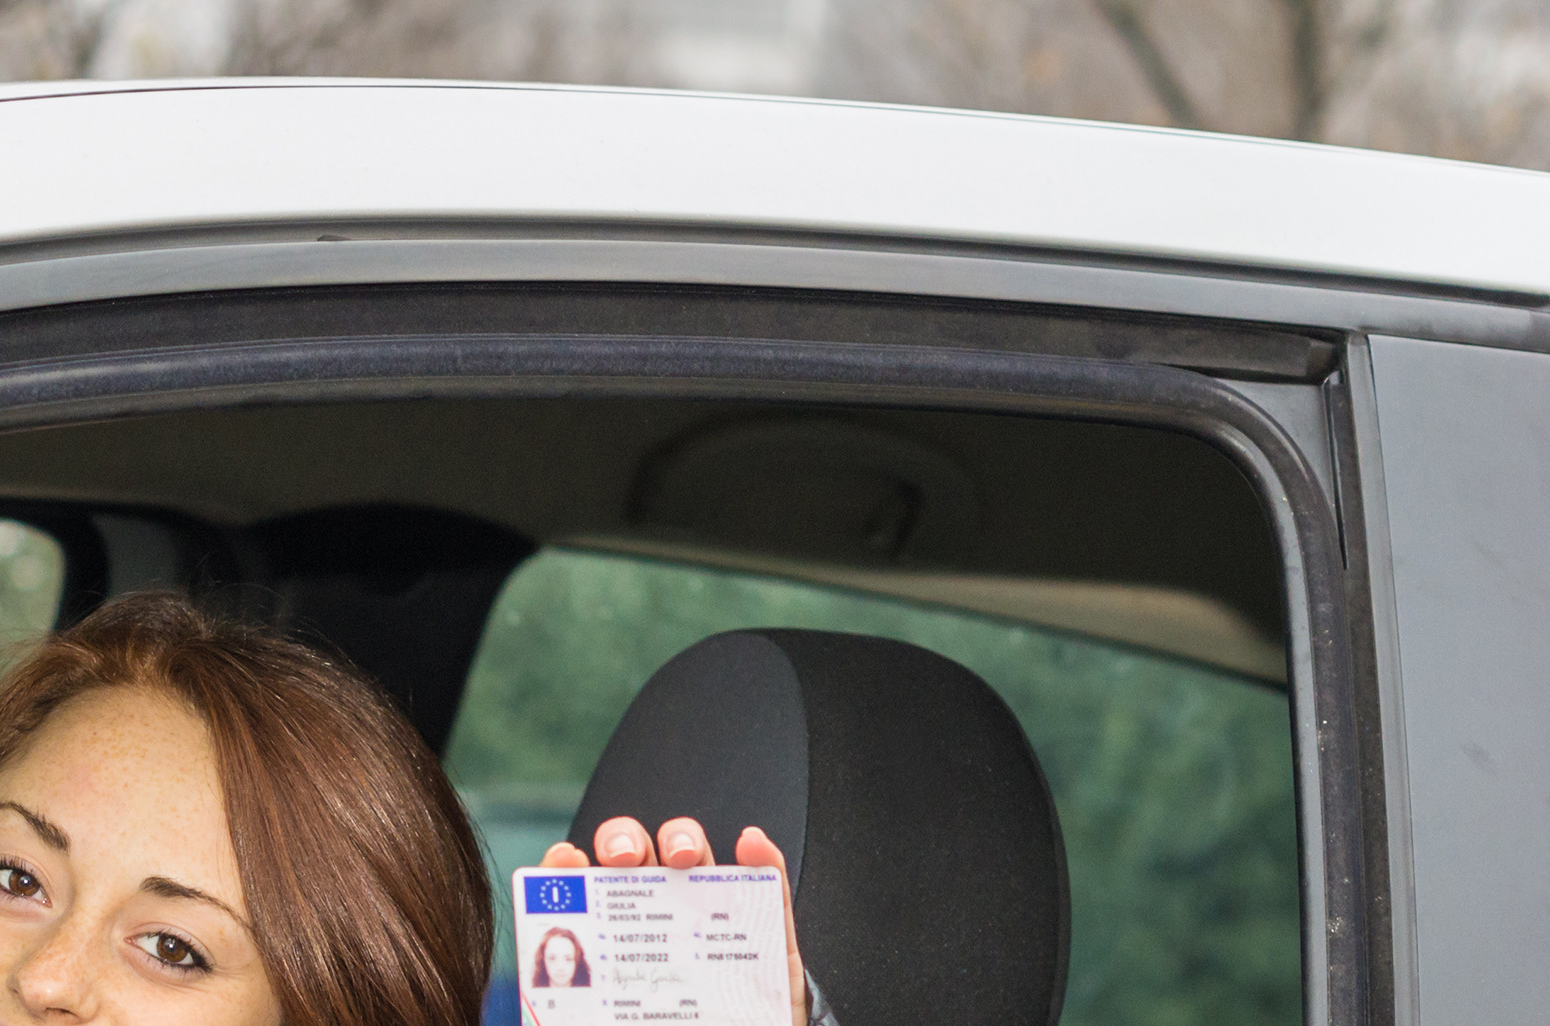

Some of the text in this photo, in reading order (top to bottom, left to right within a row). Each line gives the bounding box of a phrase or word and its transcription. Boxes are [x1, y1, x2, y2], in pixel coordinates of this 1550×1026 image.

[689, 875, 739, 883] REPUBBLICA
[711, 913, 729, 921] (RN)
[614, 934, 667, 942] 14/07/2012
[615, 953, 668, 962] 14/07/2022
[643, 1012, 692, 1020] BARAVELLI
